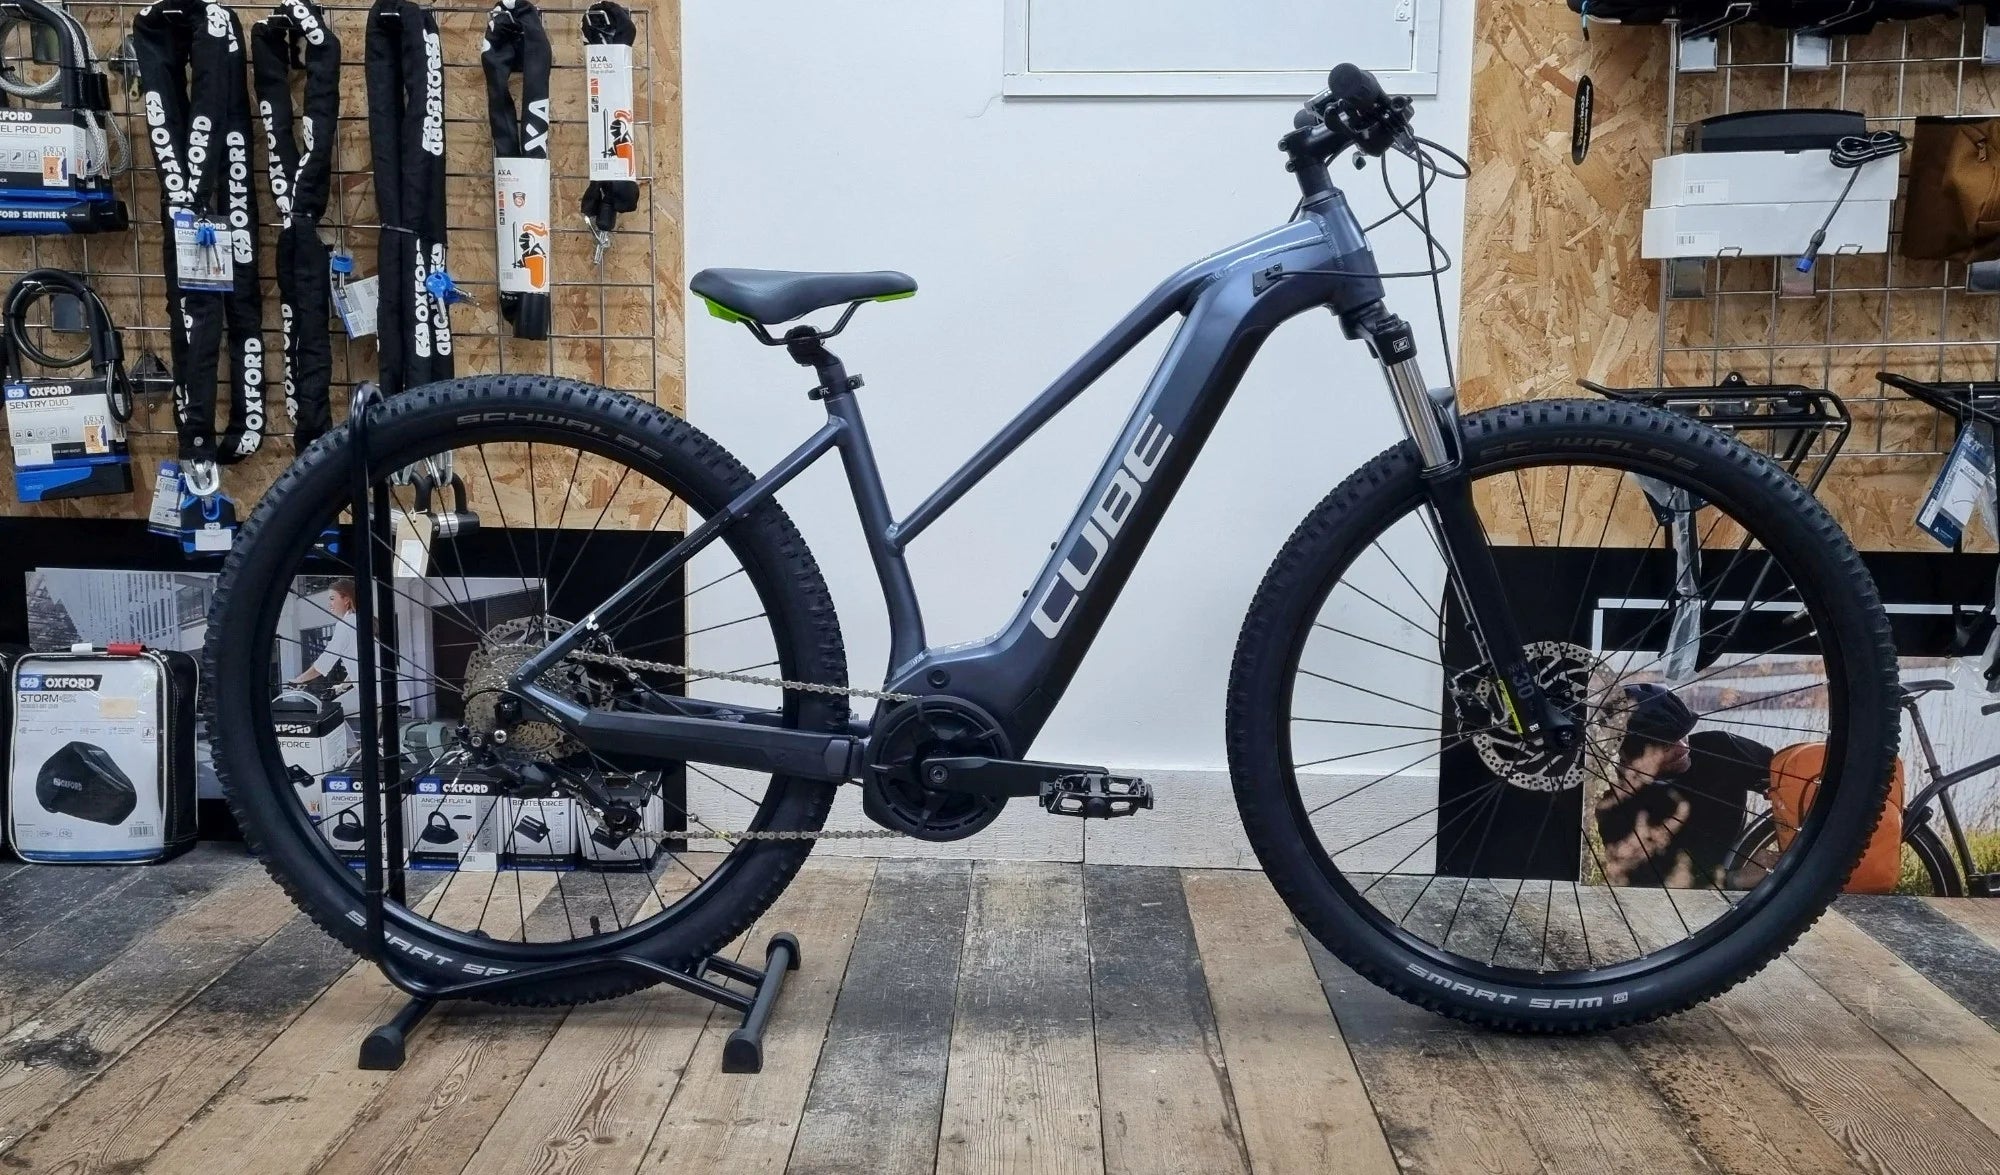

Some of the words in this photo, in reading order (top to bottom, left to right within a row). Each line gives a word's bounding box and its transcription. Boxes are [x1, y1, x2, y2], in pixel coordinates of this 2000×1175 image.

[15, 126, 37, 134] PRO
[40, 126, 62, 134] DUO
[225, 131, 248, 228] OXFORD
[22, 211, 68, 219] SENTINEL+
[244, 337, 262, 431] OXFORD
[29, 385, 72, 397] OXFORD
[9, 401, 46, 410] SENTRY
[49, 398, 70, 407] DUO
[456, 412, 664, 461] SCHWALBE
[1031, 412, 1174, 640] CUBE
[45, 677, 95, 689] OXFORD
[274, 724, 312, 734] XFORD
[442, 783, 489, 794] OXFORD
[345, 910, 453, 966] SART
[1406, 962, 1518, 1005] SMART
[1529, 997, 1603, 1009] SAM
